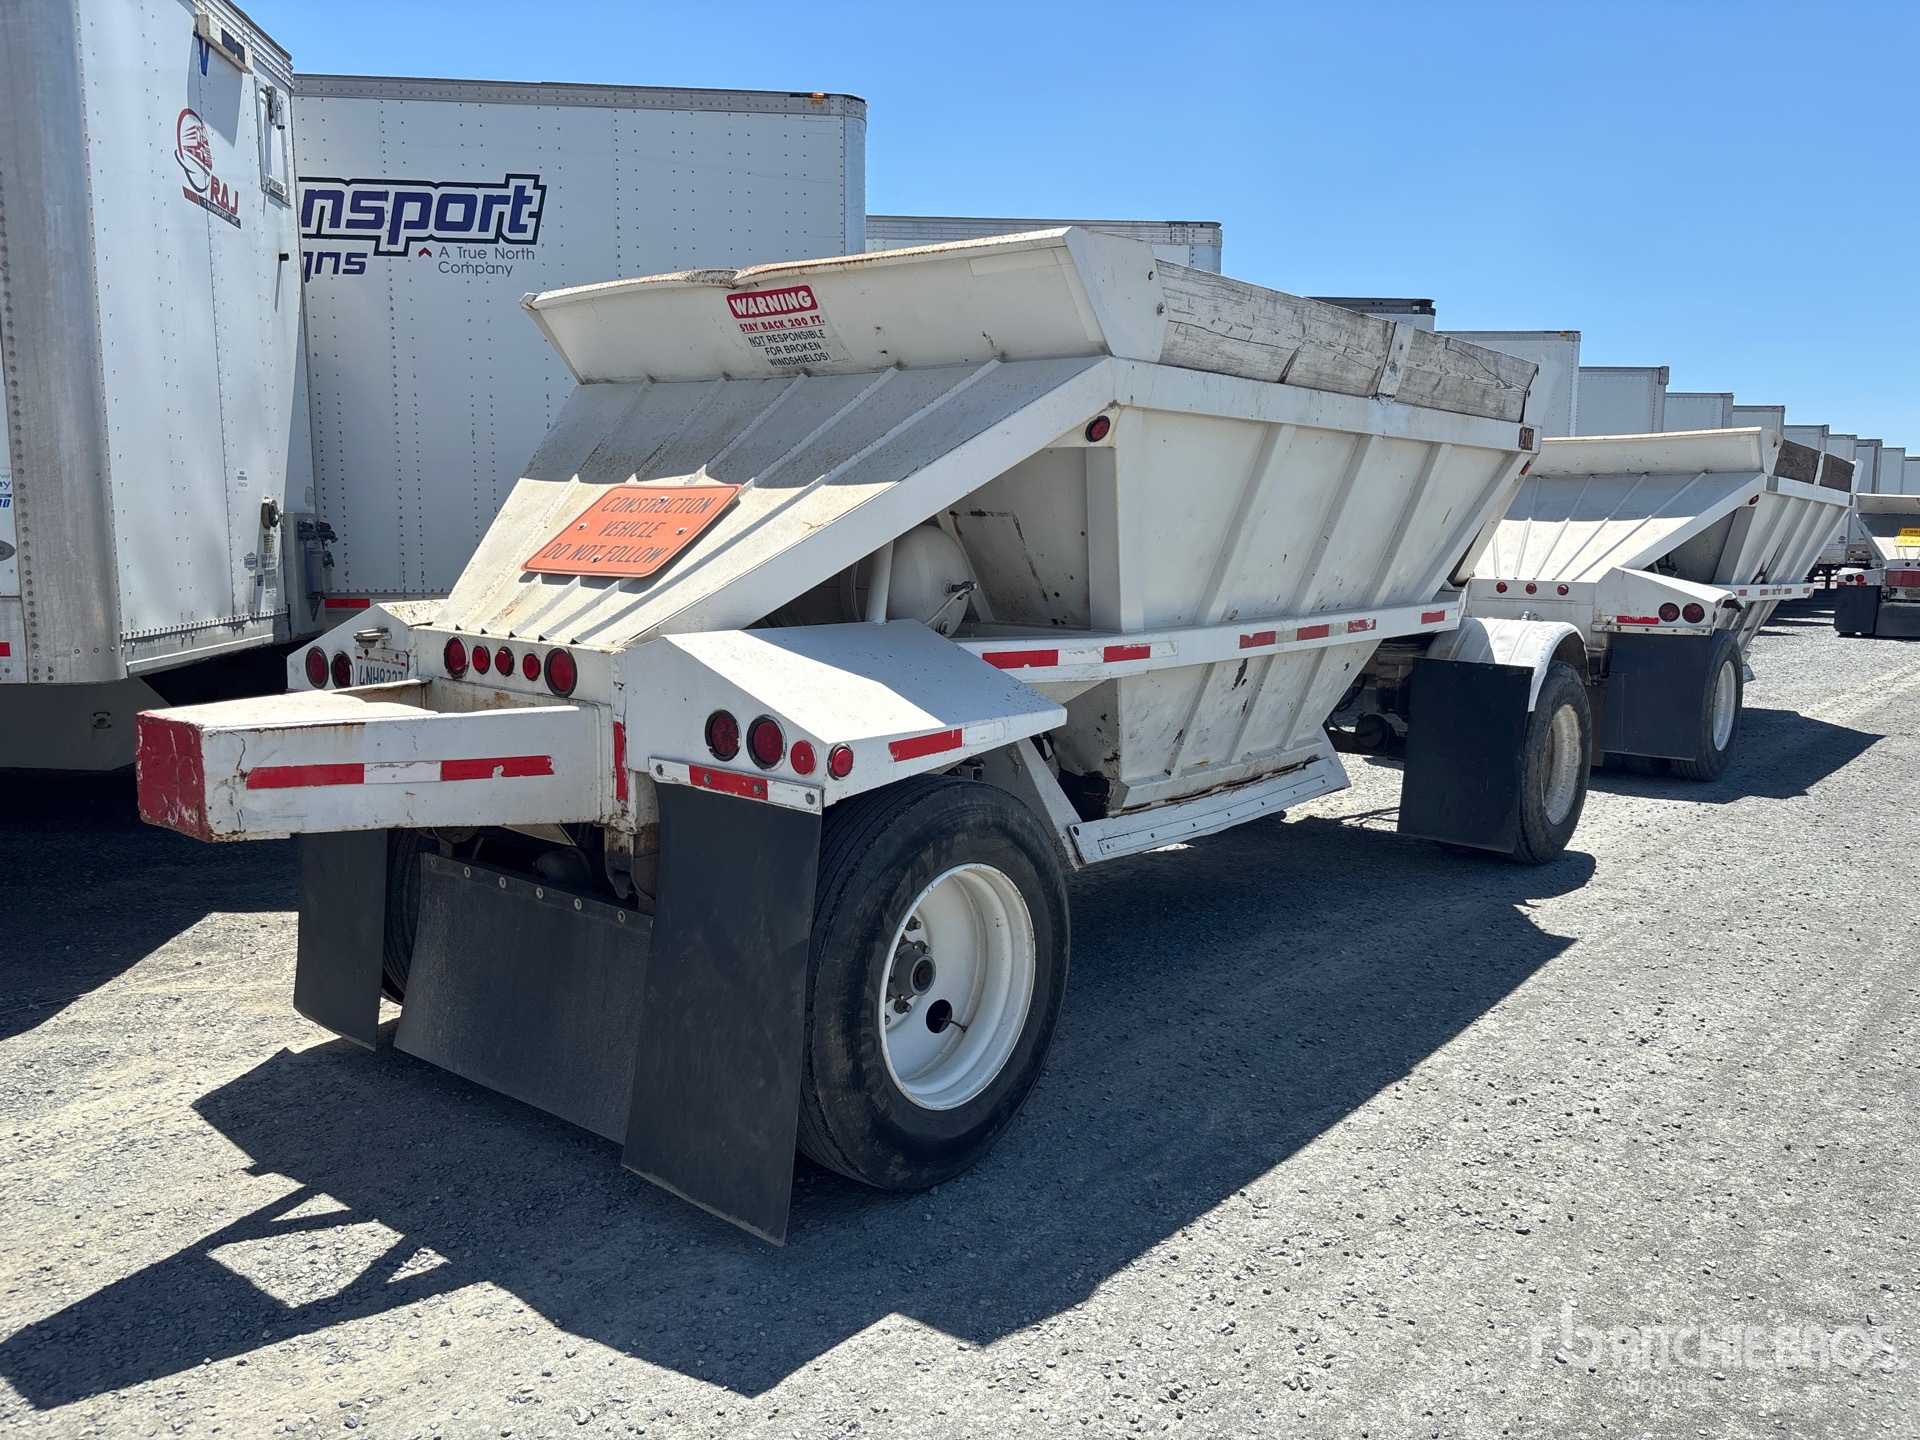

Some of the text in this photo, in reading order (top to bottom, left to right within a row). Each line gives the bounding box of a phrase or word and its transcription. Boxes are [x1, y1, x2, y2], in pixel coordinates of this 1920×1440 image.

[210, 174, 239, 216] RAJ
[438, 246, 536, 261] A True North
[438, 260, 514, 278] Company
[730, 290, 813, 316] WARNING
[739, 314, 826, 333] STAY BACK 200 FT.
[748, 329, 826, 347] NOT RESPONSIBLE
[764, 341, 823, 357] FOR BROKEN
[767, 352, 832, 368] WINDSHIELDS!
[1520, 430, 1533, 448] 210
[601, 496, 718, 515] CONSTRUCTION
[598, 521, 667, 539] VEHICLE
[542, 542, 669, 564] DO NOT FOLLOW
